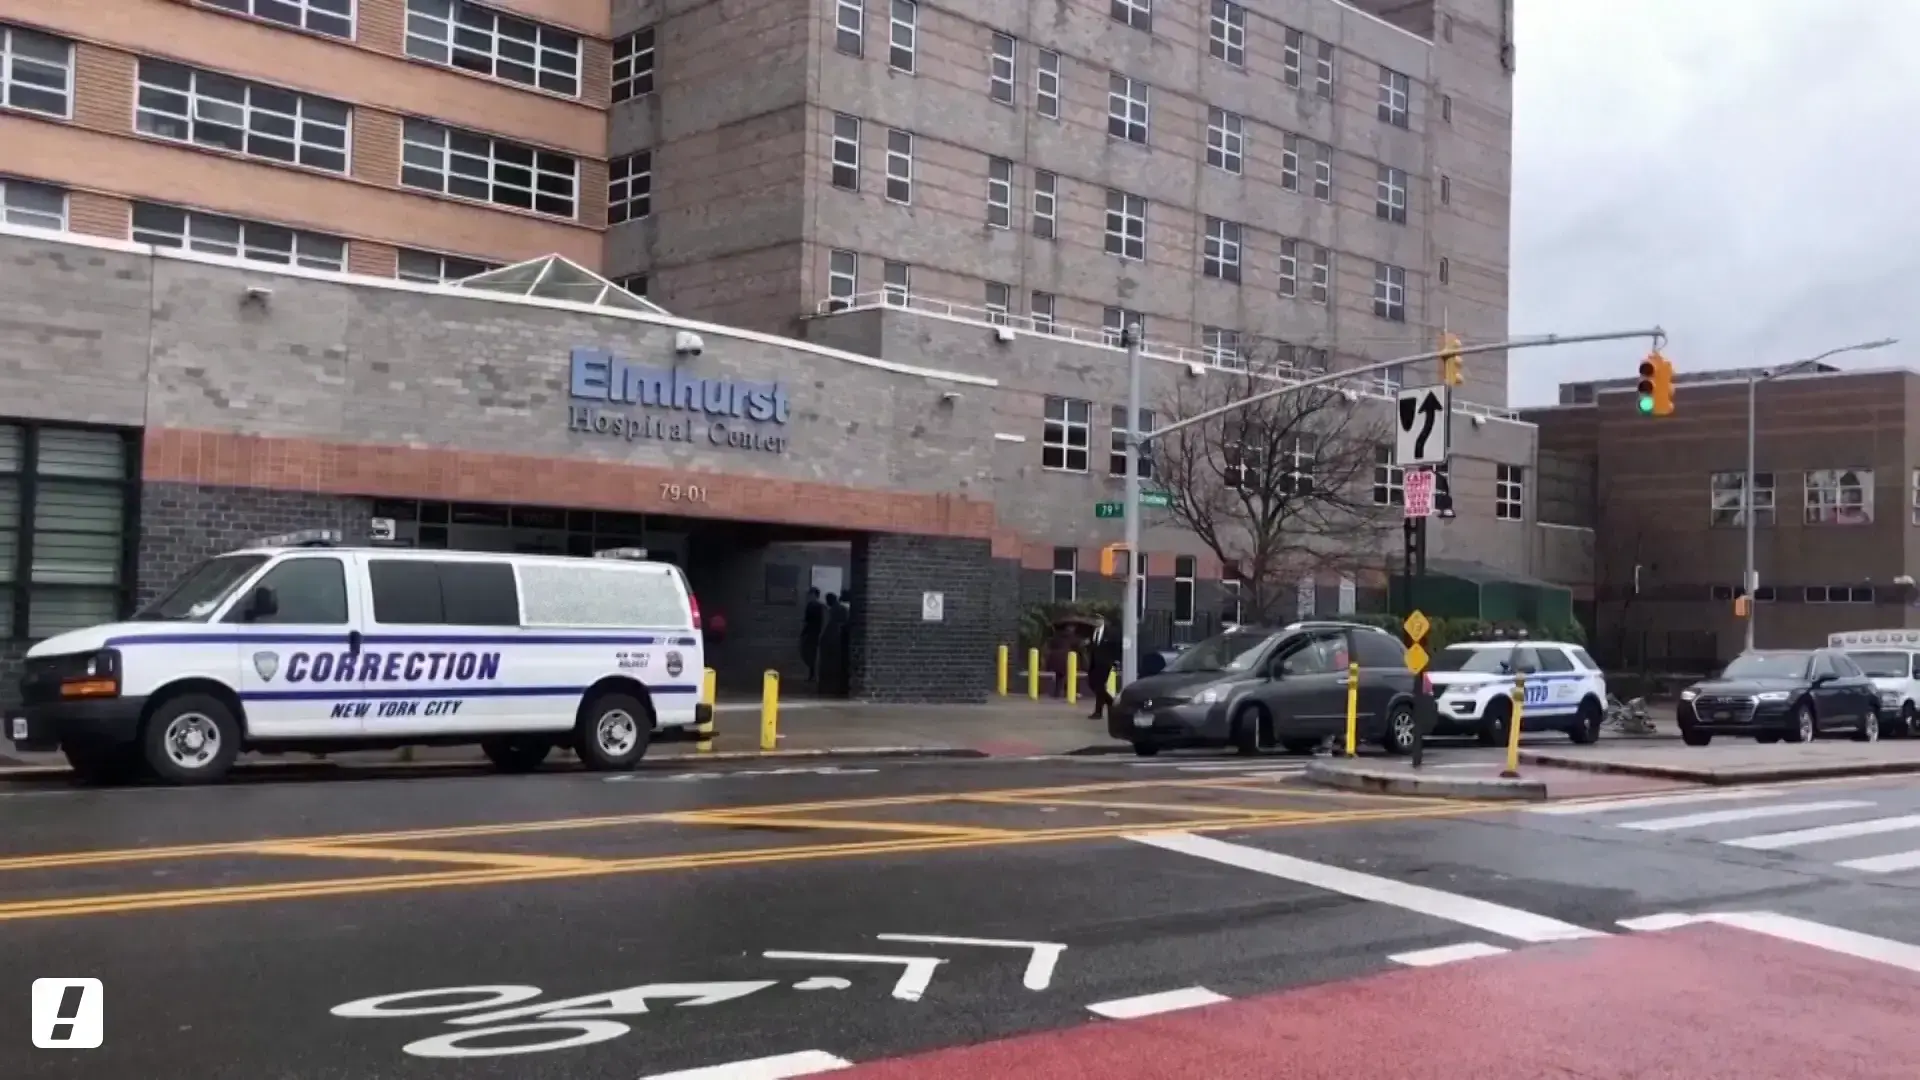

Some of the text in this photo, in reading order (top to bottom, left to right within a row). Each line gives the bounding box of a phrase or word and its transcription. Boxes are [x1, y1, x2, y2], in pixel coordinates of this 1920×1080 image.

[570, 347, 789, 425] Elmhurst
[569, 405, 788, 453] Hospital Center
[660, 483, 707, 501] 79-01
[285, 652, 501, 682] CORRECTION
[330, 700, 463, 719] NEW YORK CITY
